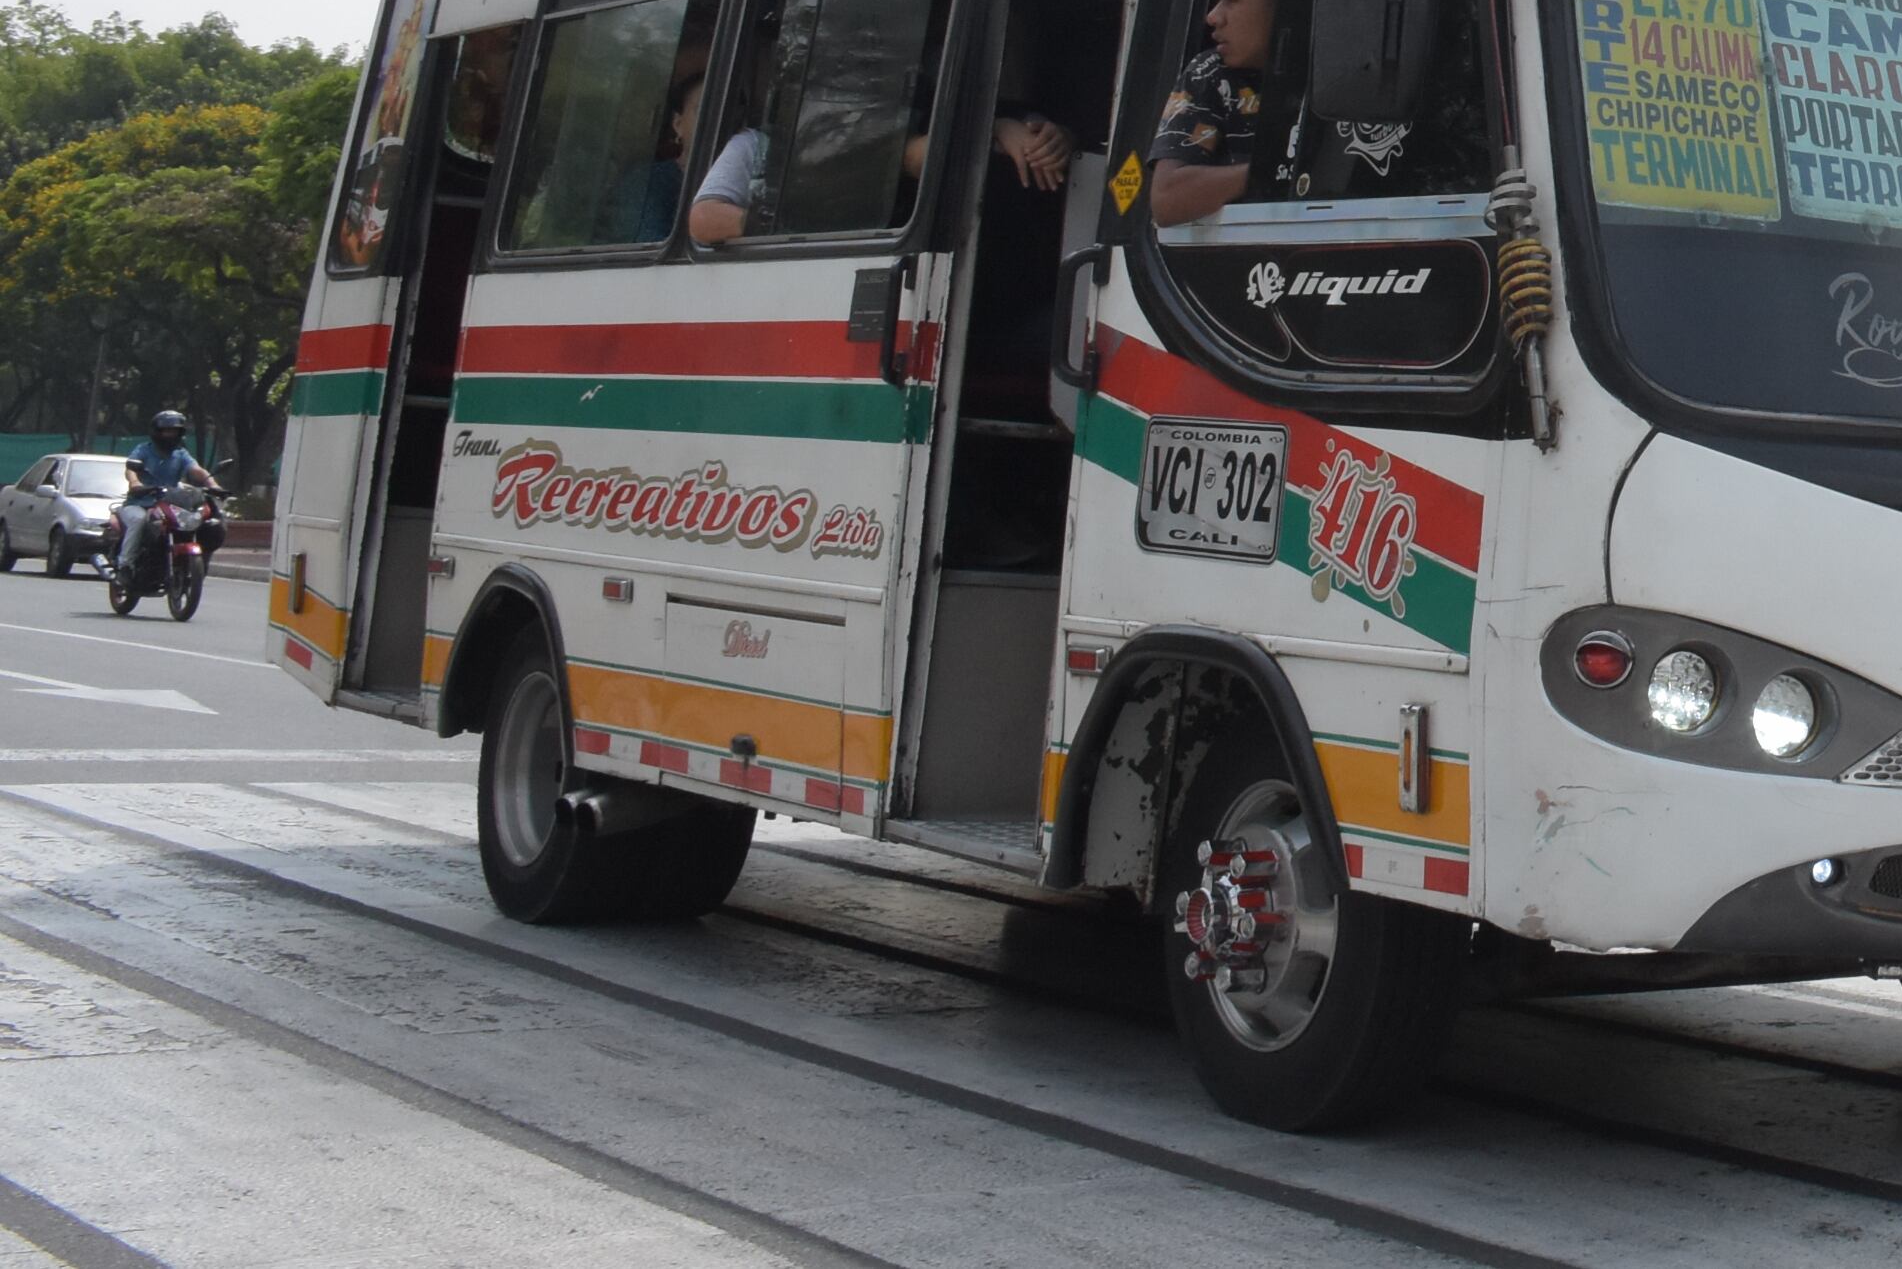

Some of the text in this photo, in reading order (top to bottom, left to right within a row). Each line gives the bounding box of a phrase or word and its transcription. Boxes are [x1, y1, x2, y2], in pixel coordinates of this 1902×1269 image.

[1630, 19, 1759, 83] 14 CALIMA
[1634, 70, 1761, 114] SAMECO
[1599, 98, 1760, 144] CHIPICHAPE
[1591, 128, 1775, 200] TERMINAL
[1288, 268, 1432, 305] liquid
[1170, 430, 1262, 445] COLOMBIA
[493, 440, 815, 550] Recreativos
[1150, 445, 1277, 523] VCI 302
[812, 506, 883, 558] Ltda
[1169, 529, 1238, 546] CALI
[1312, 451, 1415, 599] 416
